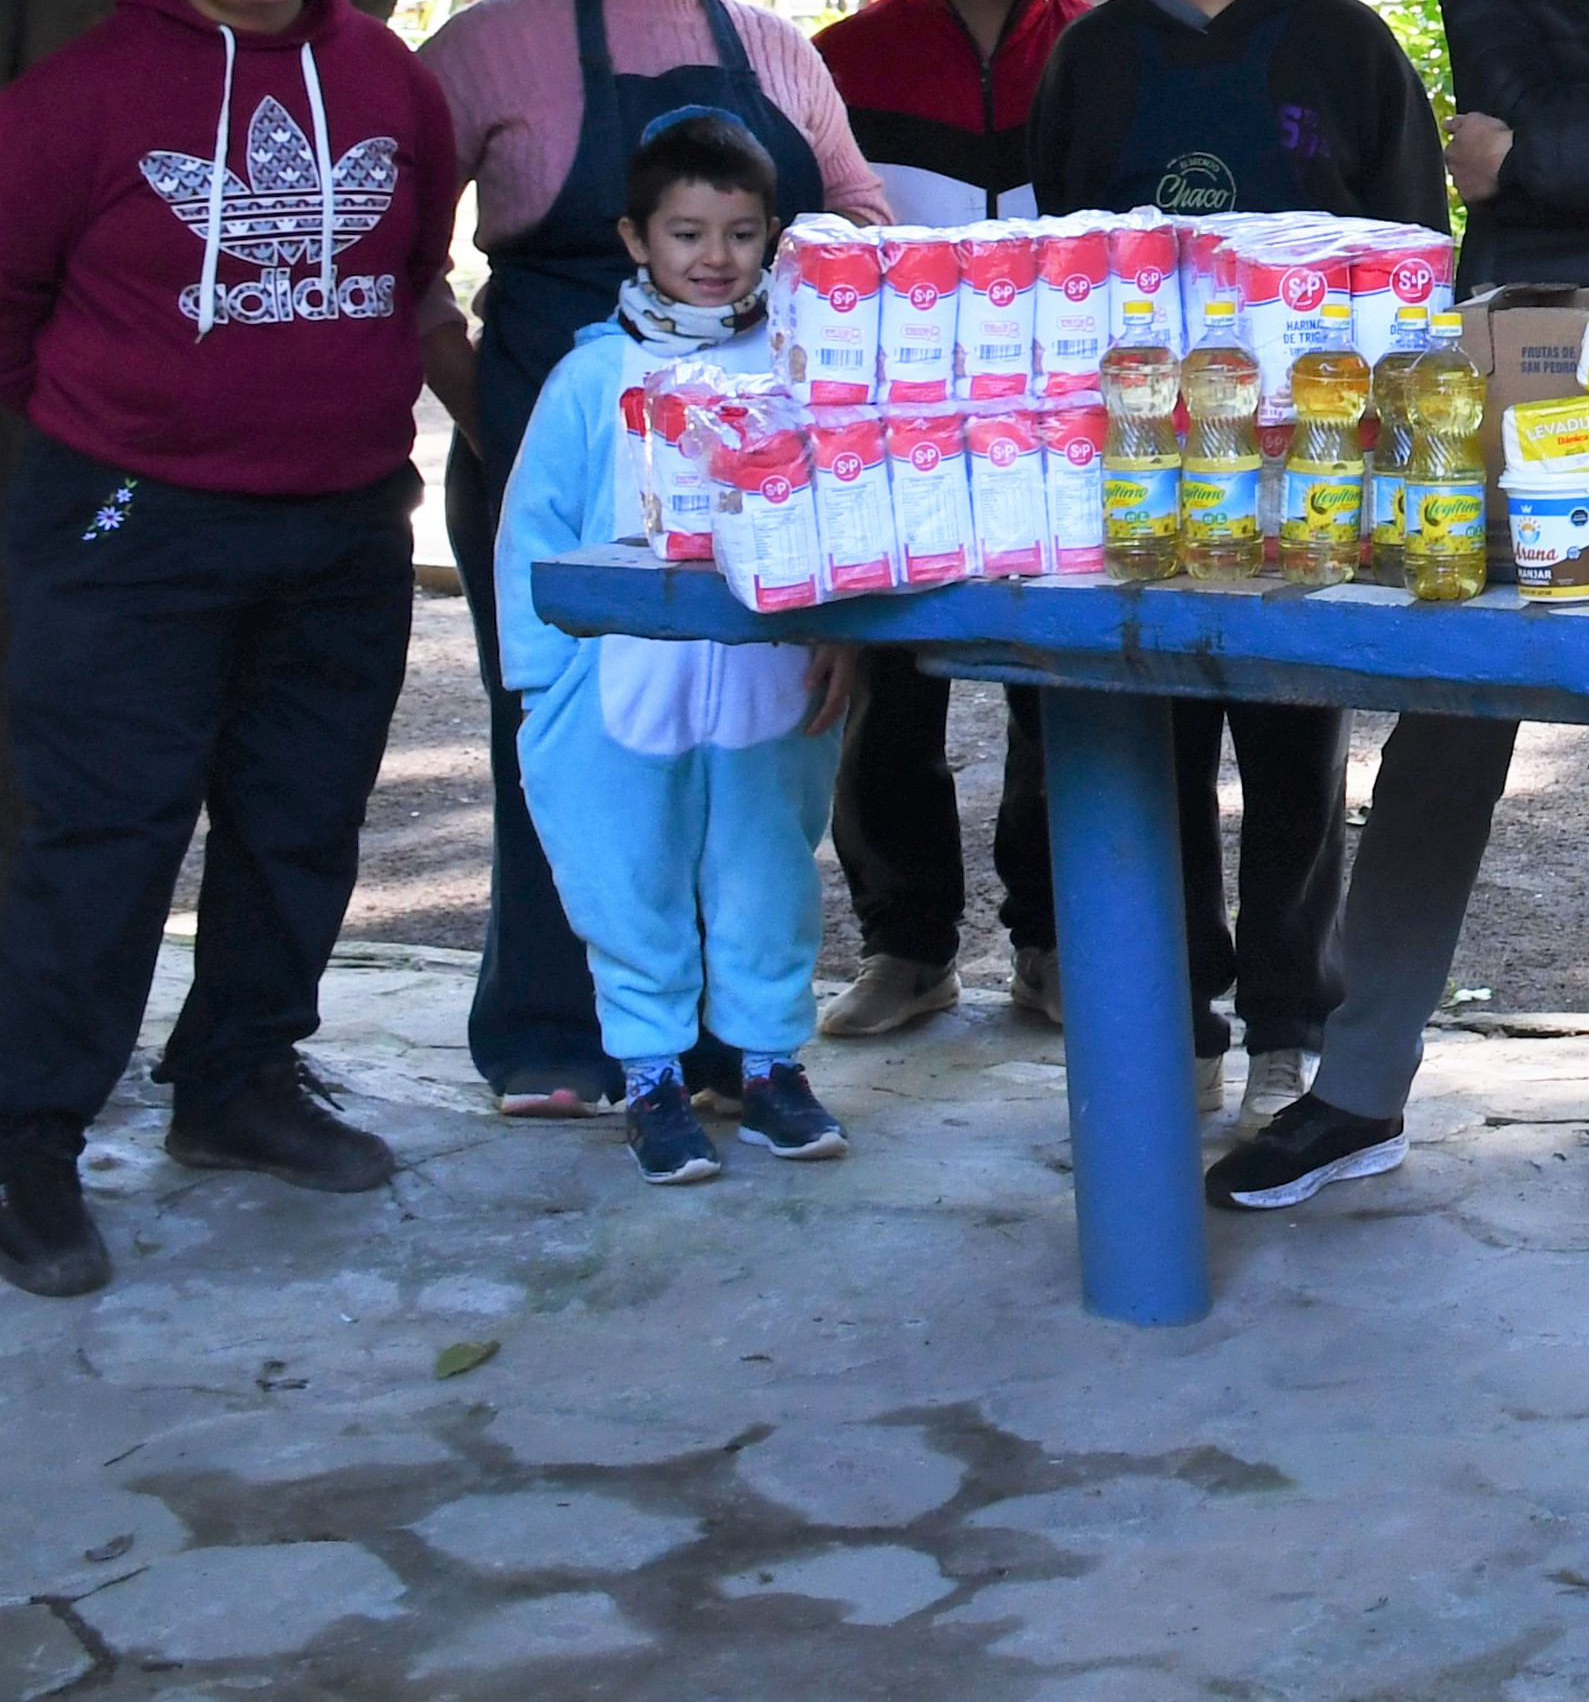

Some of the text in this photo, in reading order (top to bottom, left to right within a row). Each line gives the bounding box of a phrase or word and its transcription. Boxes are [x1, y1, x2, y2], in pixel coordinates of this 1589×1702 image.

[1156, 174, 1232, 209] Chaco
[1399, 269, 1430, 291] S&P
[178, 266, 396, 325] adidas
[1283, 333, 1298, 344] DE
[1521, 346, 1576, 359] FRUTAS DE
[1521, 361, 1578, 374] SAN PEDRO
[1517, 568, 1553, 580] MANJAR
